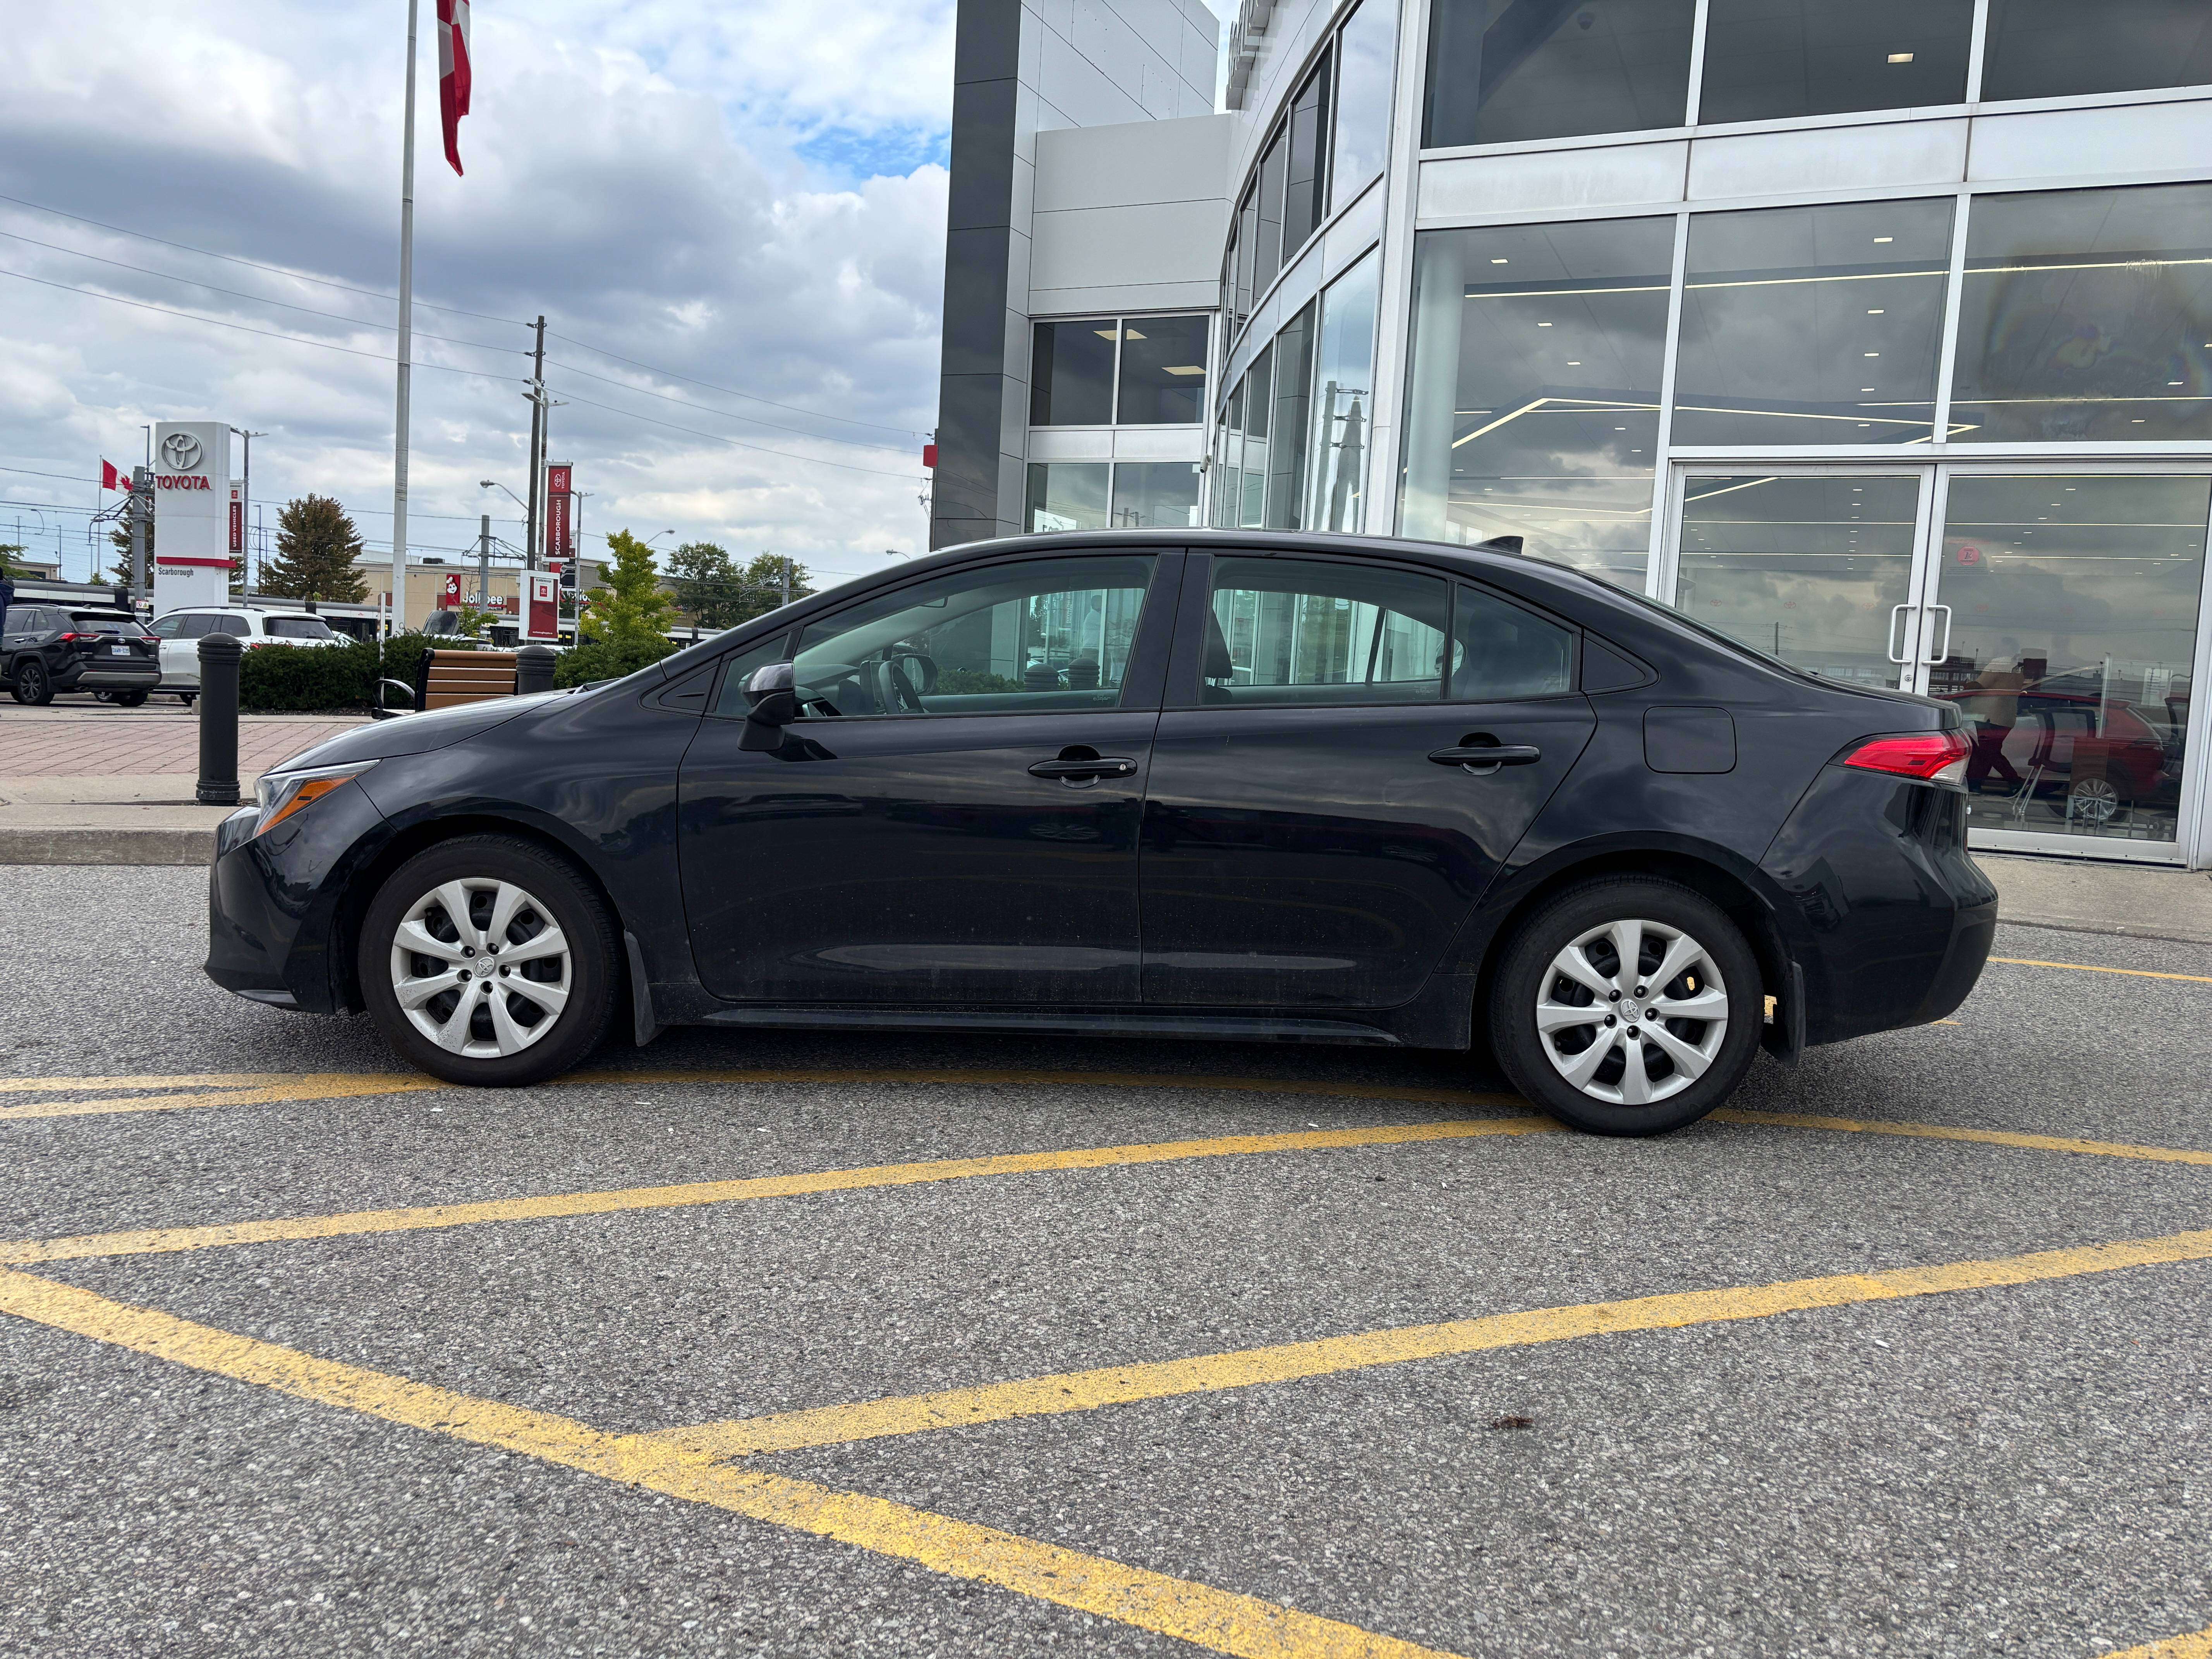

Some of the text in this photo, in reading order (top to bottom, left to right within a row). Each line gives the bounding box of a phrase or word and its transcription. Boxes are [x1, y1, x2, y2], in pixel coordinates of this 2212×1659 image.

[155, 475, 211, 489] TOYOTA
[158, 567, 194, 577] Scarborough
[462, 591, 503, 605] Jollee
